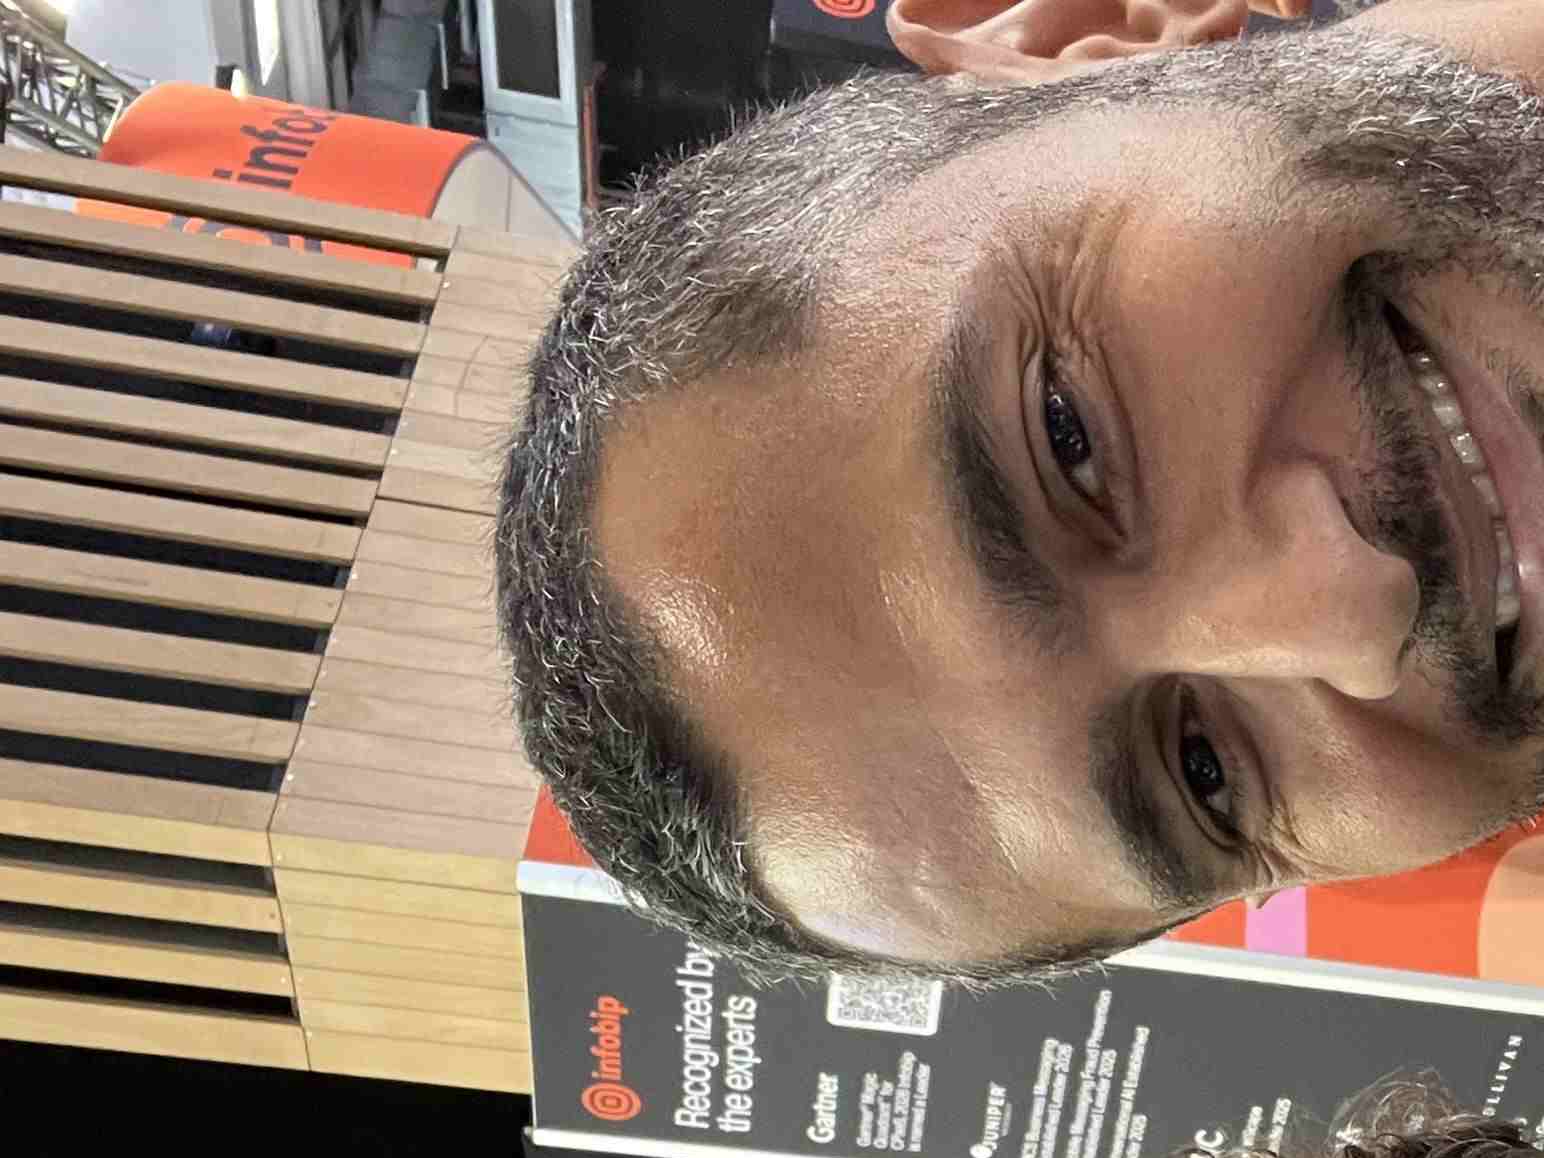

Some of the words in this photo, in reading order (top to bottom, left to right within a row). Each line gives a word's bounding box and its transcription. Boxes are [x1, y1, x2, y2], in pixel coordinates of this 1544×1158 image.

[212, 105, 337, 190] info
[675, 941, 715, 977] by
[590, 995, 631, 1080] infobip
[674, 980, 719, 1129] Recognized
[721, 995, 762, 1091] experts
[721, 1093, 754, 1133] the
[806, 1072, 840, 1144] Gartner
[981, 1083, 1007, 1151] JUNIPER
